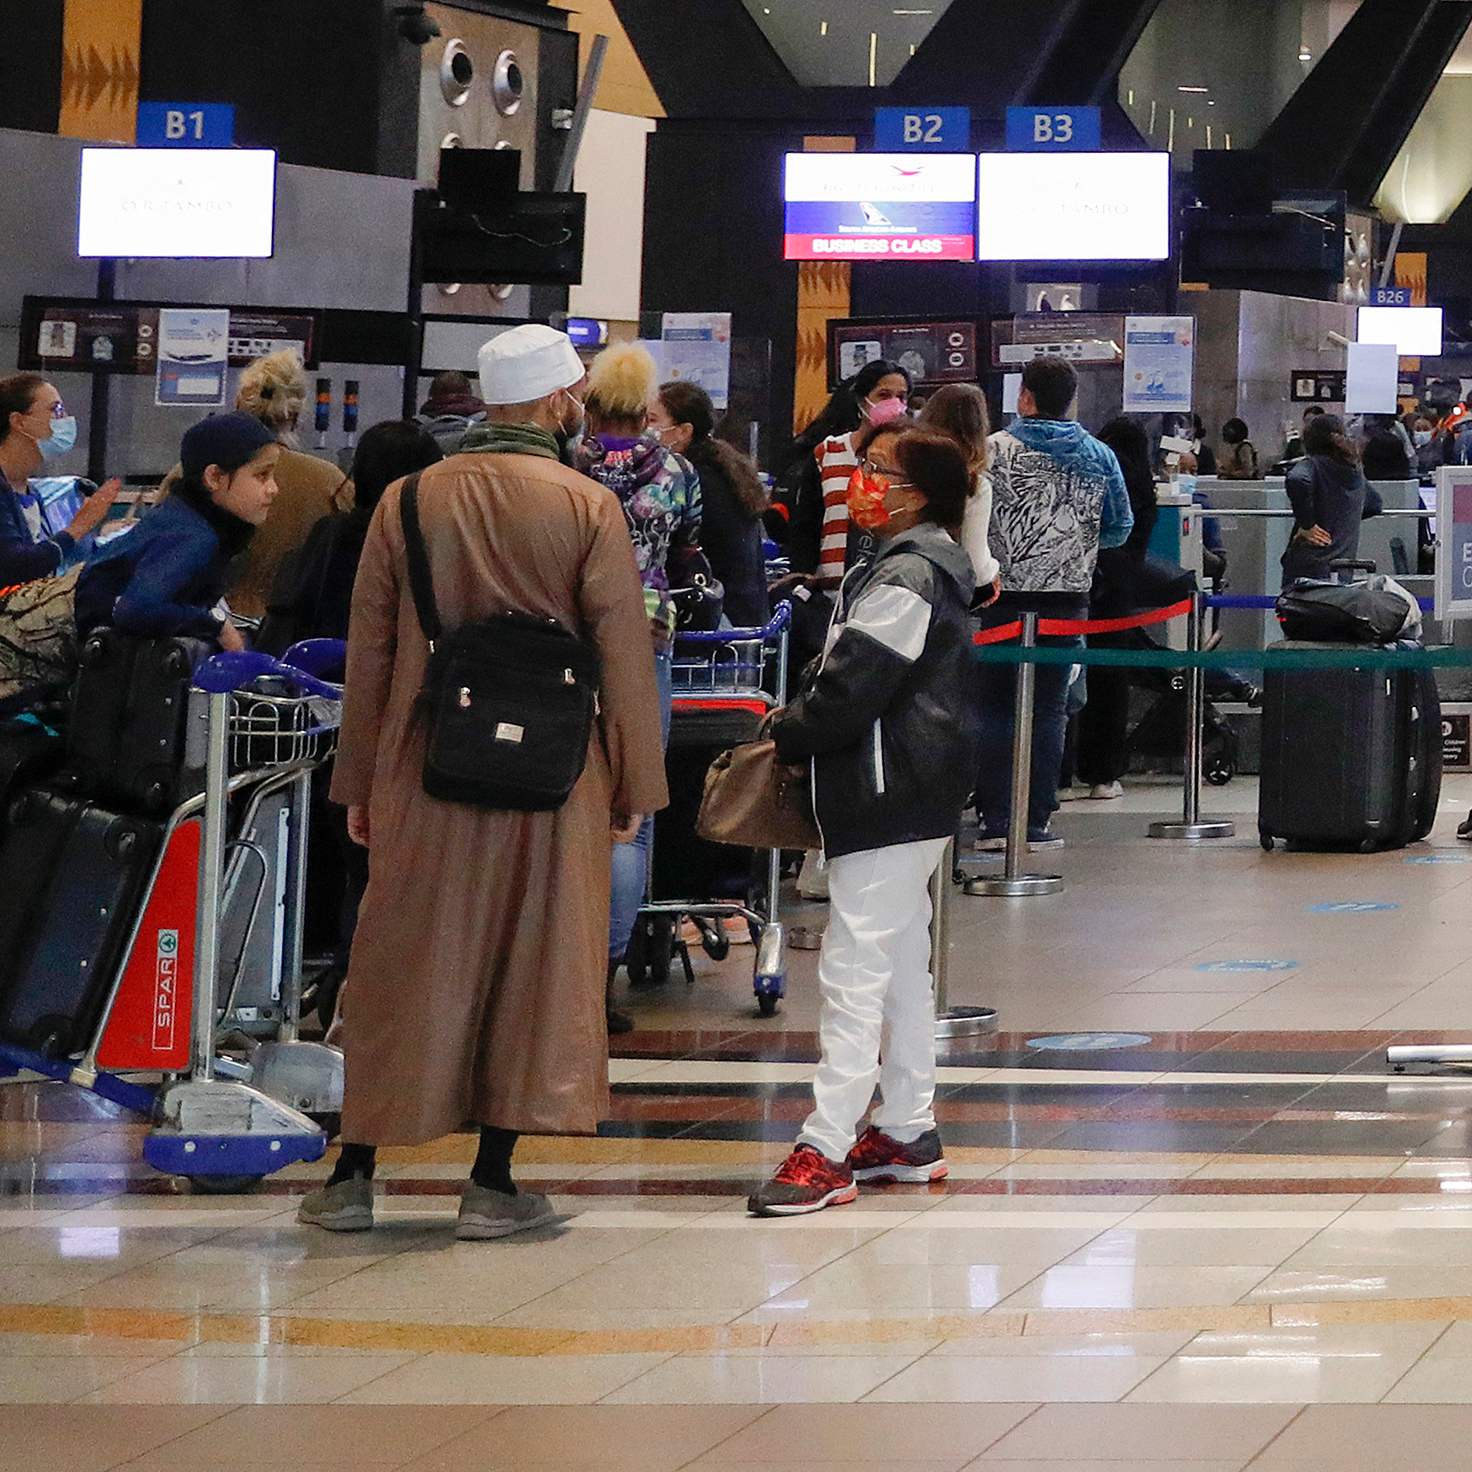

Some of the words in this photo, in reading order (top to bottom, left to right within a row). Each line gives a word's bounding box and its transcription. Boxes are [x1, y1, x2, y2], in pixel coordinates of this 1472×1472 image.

[165, 110, 204, 140] B1
[903, 115, 944, 143] B2
[1033, 114, 1073, 143] B3
[812, 239, 889, 253] BUSINESS
[891, 239, 943, 253] CLASS
[1377, 291, 1404, 304] B26
[157, 959, 173, 1028] SPAR
